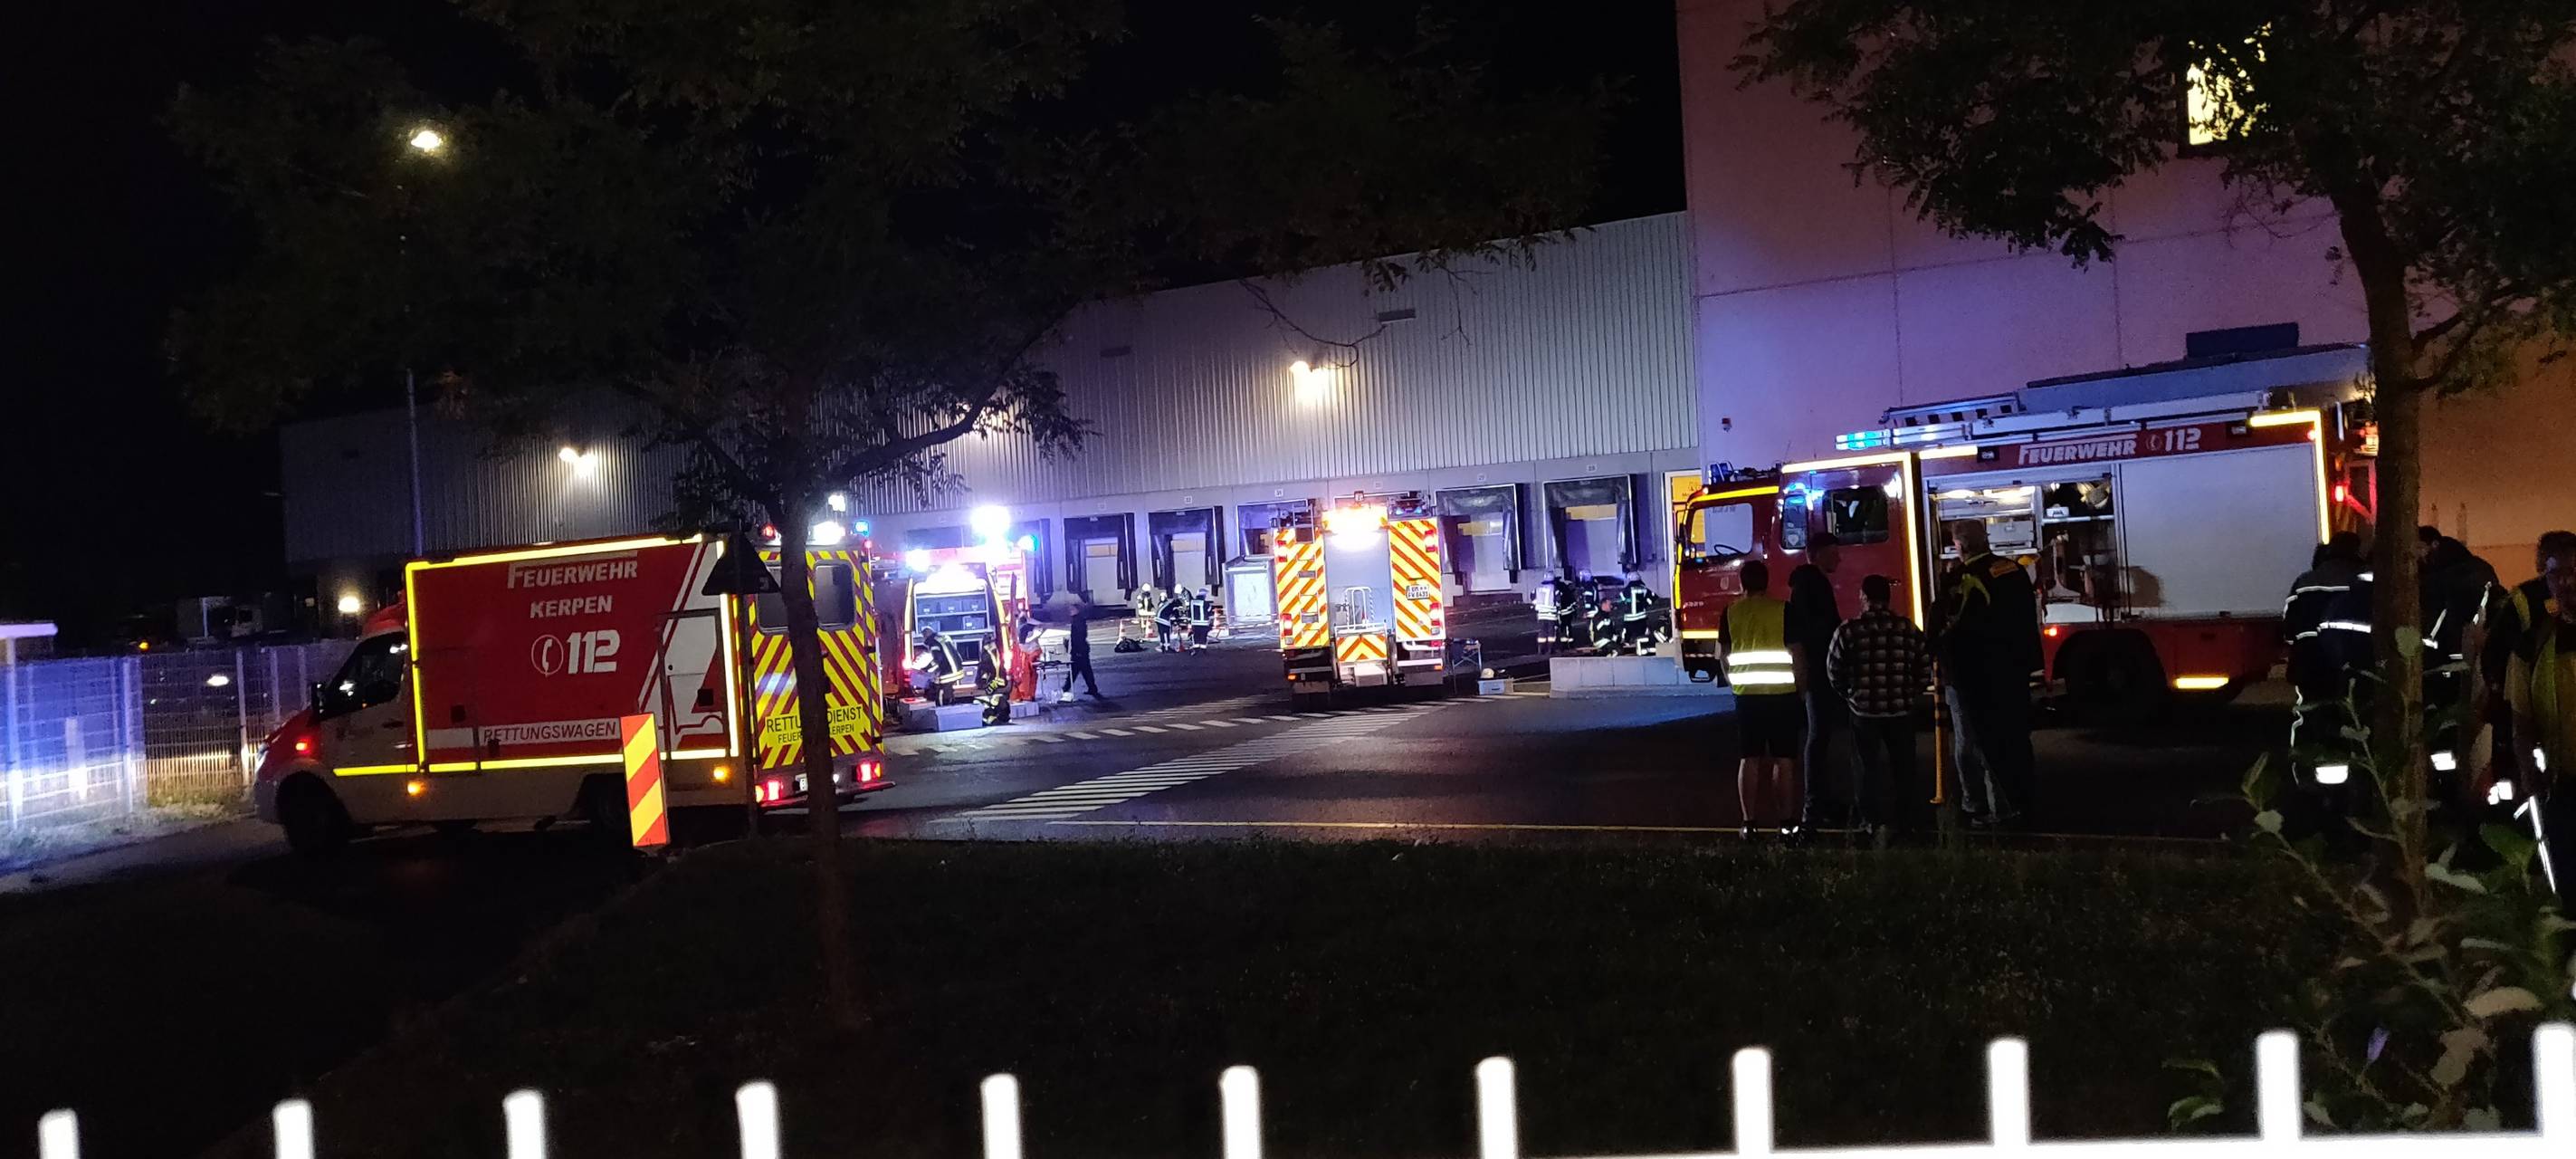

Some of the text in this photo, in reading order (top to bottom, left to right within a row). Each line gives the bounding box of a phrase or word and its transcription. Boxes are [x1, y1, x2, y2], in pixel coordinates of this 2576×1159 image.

[2018, 427, 2202, 465] FEUERWEHR 112
[507, 550, 638, 589] FEUERWEHR
[530, 595, 613, 618] KERPEN
[567, 629, 621, 674] 112
[483, 722, 616, 743] RETTUNGSWAGEN
[832, 723, 854, 734] ERPEN
